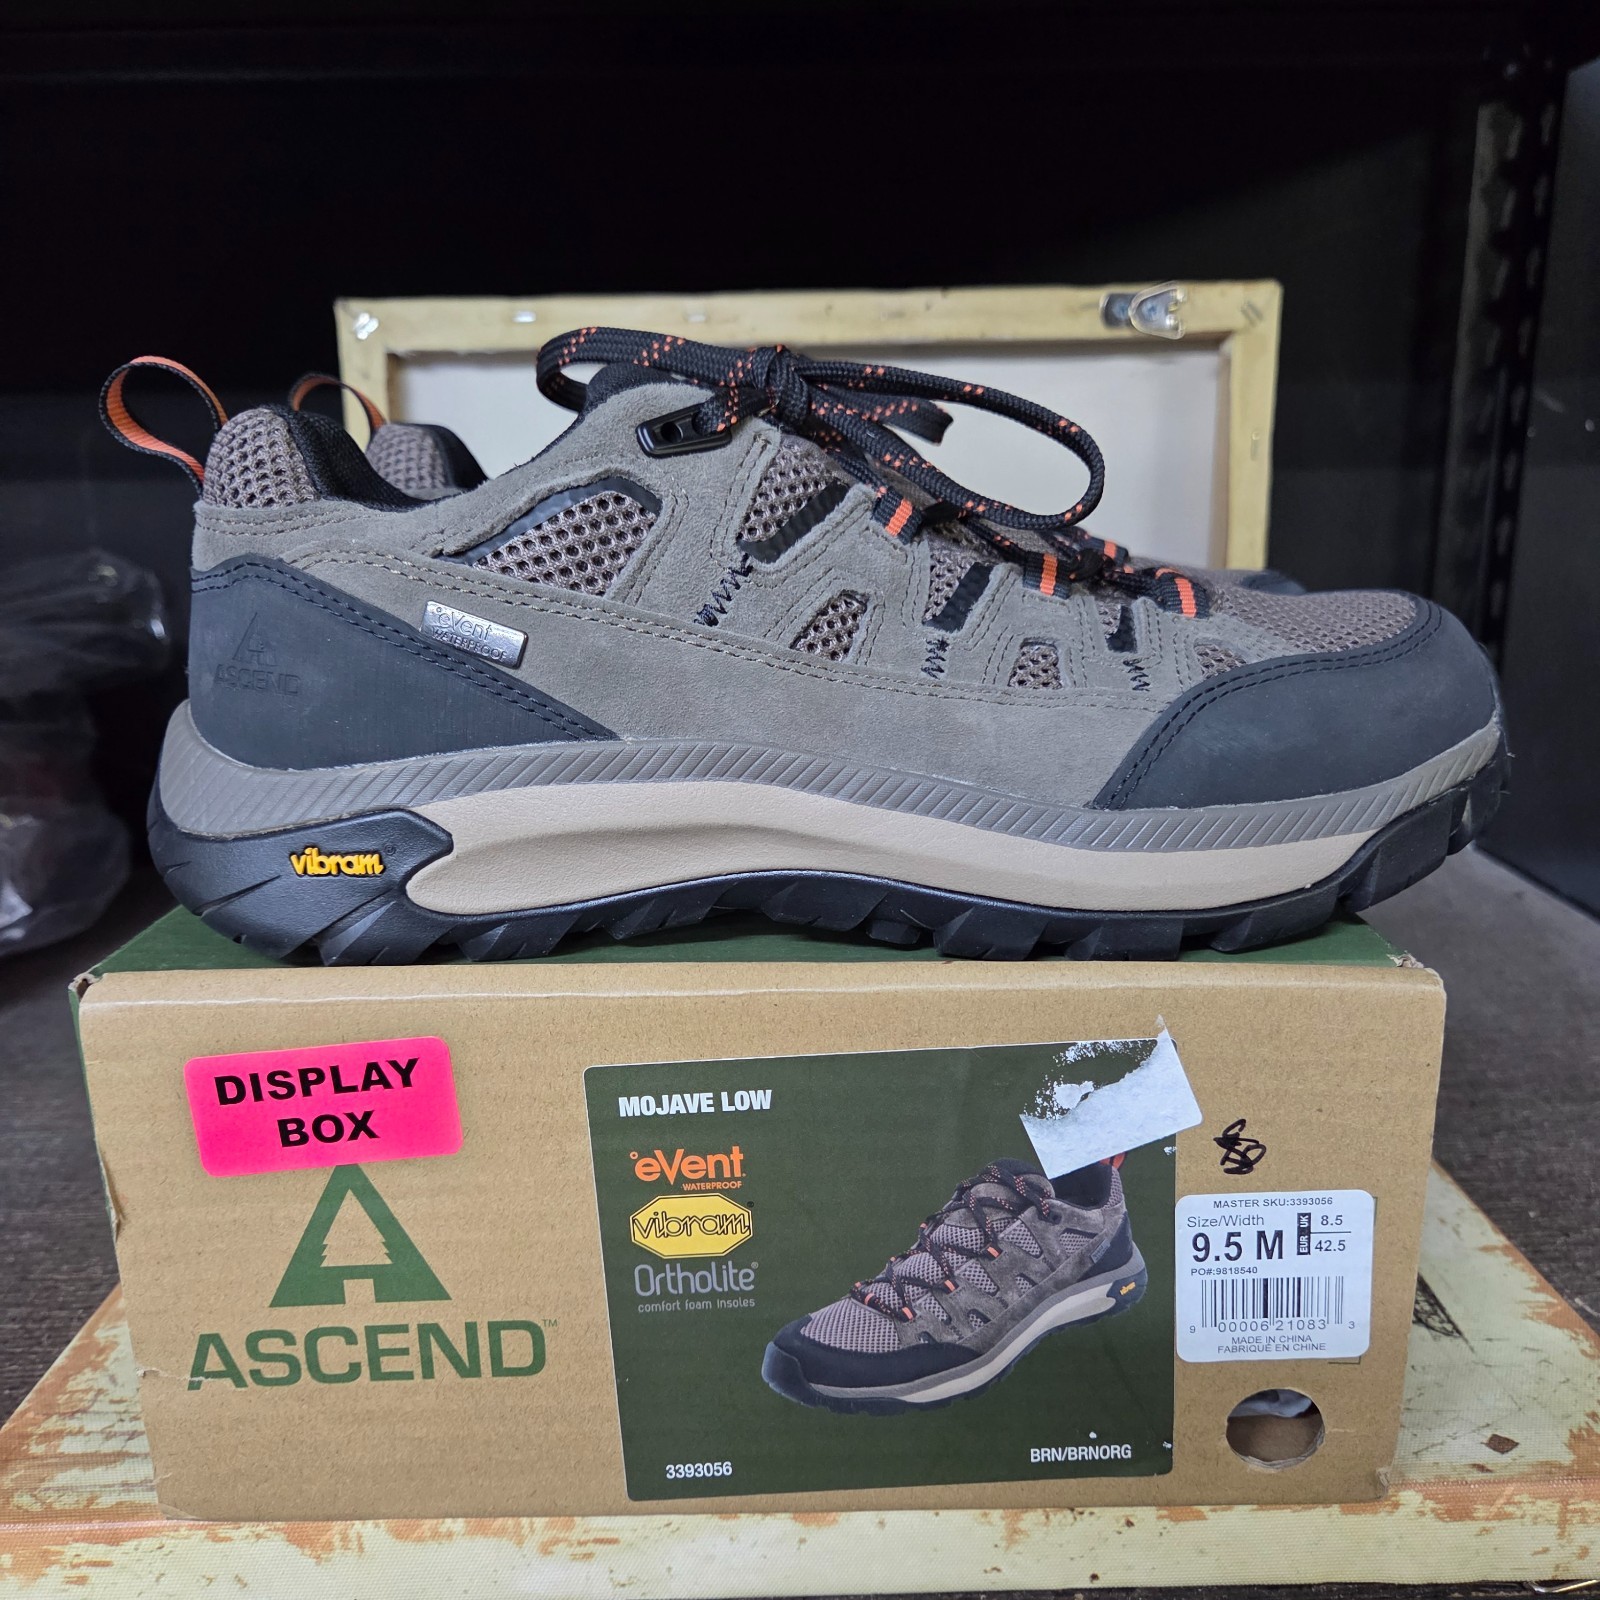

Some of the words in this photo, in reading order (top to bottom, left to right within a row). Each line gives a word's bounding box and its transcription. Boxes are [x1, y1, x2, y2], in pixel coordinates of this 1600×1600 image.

[215, 664, 301, 696] ASCEND
[290, 847, 384, 876] vibram
[214, 1058, 419, 1105] DISPLAY
[618, 1093, 714, 1117] MOJAVE
[721, 1089, 772, 1111] LOW
[277, 1110, 380, 1147] BOX
[682, 1180, 742, 1191] WATERPROOF
[1213, 1199, 1260, 1209] MASTER
[1263, 1197, 1333, 1207] SKU:3393056
[633, 1211, 749, 1239] vibram
[1187, 1214, 1265, 1228] Size/Width
[1299, 1215, 1309, 1228] UK
[1320, 1214, 1343, 1226] 8.5
[1192, 1231, 1243, 1263] 9.5
[1256, 1230, 1284, 1260] M
[1299, 1235, 1309, 1253] EUR
[1314, 1239, 1346, 1252] 42.5
[1191, 1266, 1258, 1276] PO#:9818540
[638, 1300, 681, 1313] comfort
[685, 1299, 712, 1309] foam
[1218, 1320, 1269, 1333] 00006
[1275, 1319, 1326, 1331] 21083
[1231, 1336, 1262, 1345] MADE
[1265, 1335, 1276, 1344] IN
[1279, 1335, 1312, 1343] CHINA
[1275, 1344, 1289, 1352] EN
[1293, 1343, 1326, 1351] CHINE
[187, 1319, 546, 1391] ASCEND
[1030, 1444, 1132, 1463] BRN/BRNORG
[665, 1461, 733, 1479] 3393056
